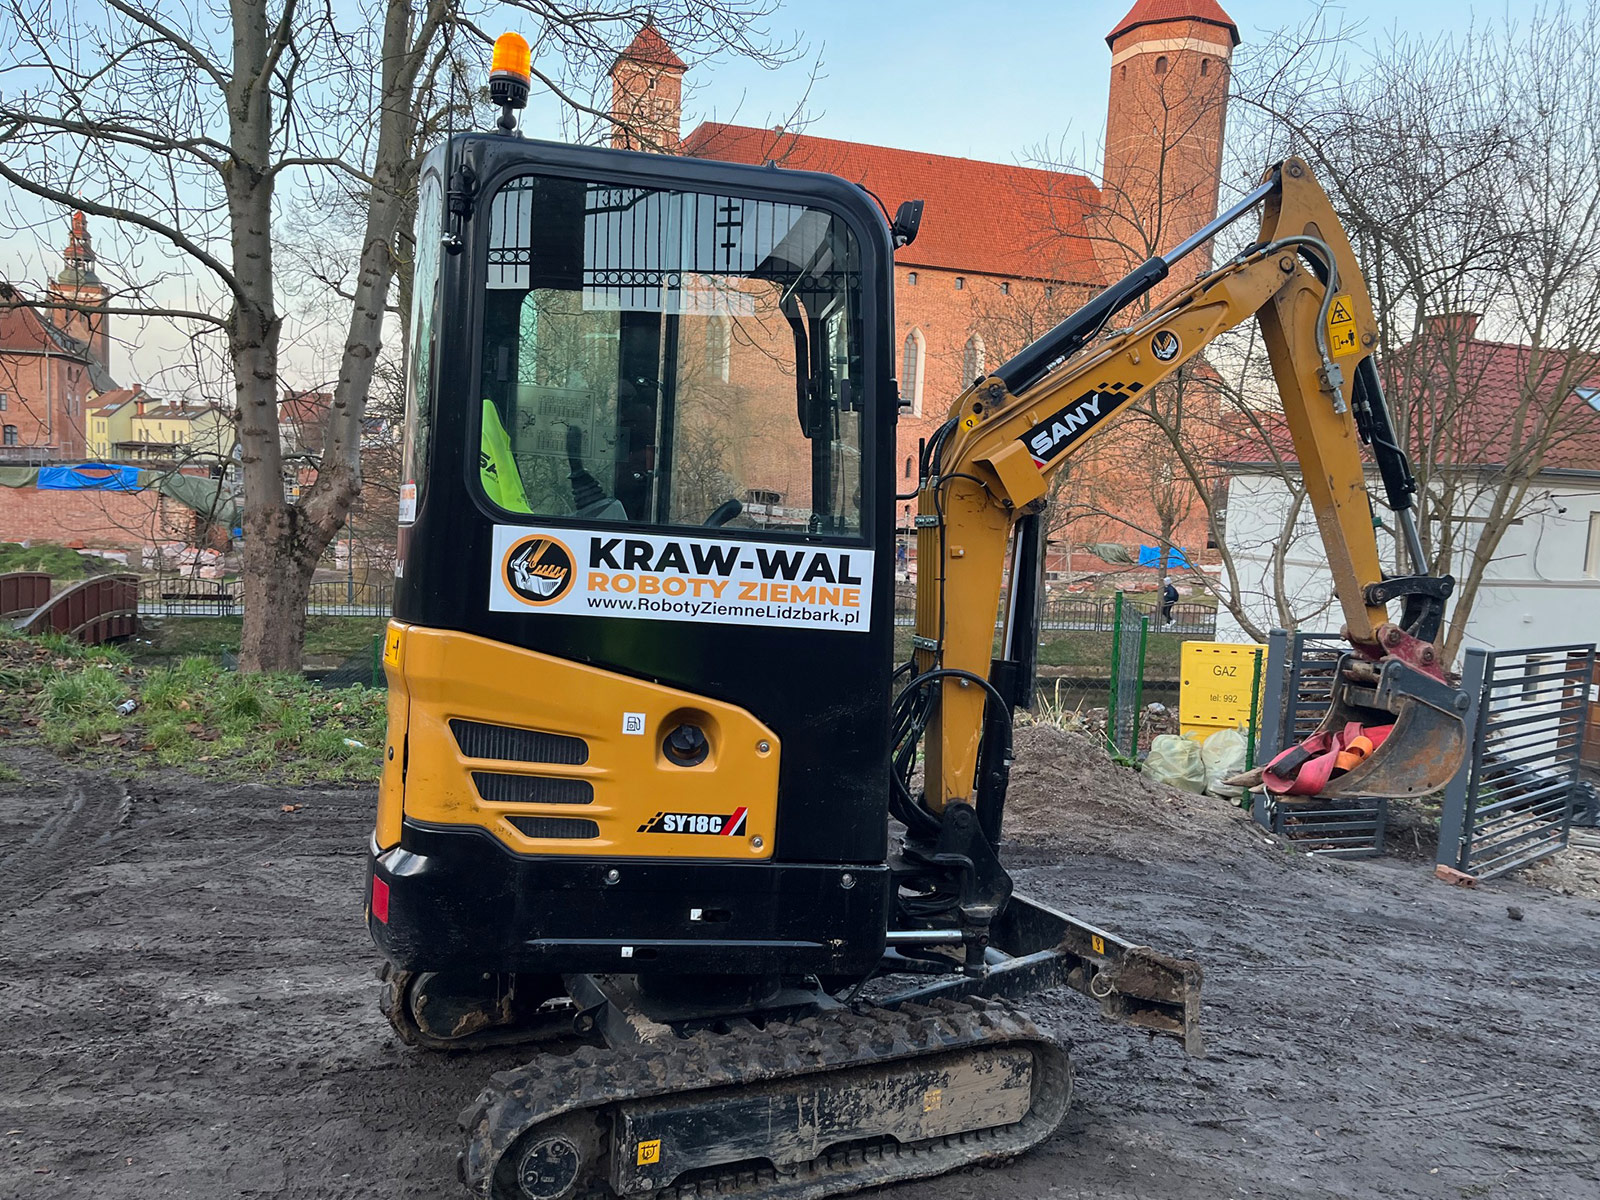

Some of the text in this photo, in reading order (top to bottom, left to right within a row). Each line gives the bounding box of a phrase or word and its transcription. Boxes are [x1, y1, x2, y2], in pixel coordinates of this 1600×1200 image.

[1031, 394, 1100, 456] SANY
[589, 537, 862, 585] KRAW-WAL
[587, 572, 860, 607] ROBOTY ZIEMNE
[587, 597, 860, 624] www.RobotyZiemneLidzbark.pl
[1213, 665, 1237, 677] GAZ
[1210, 694, 1238, 703] tel: 992
[663, 815, 722, 833] SY18C
